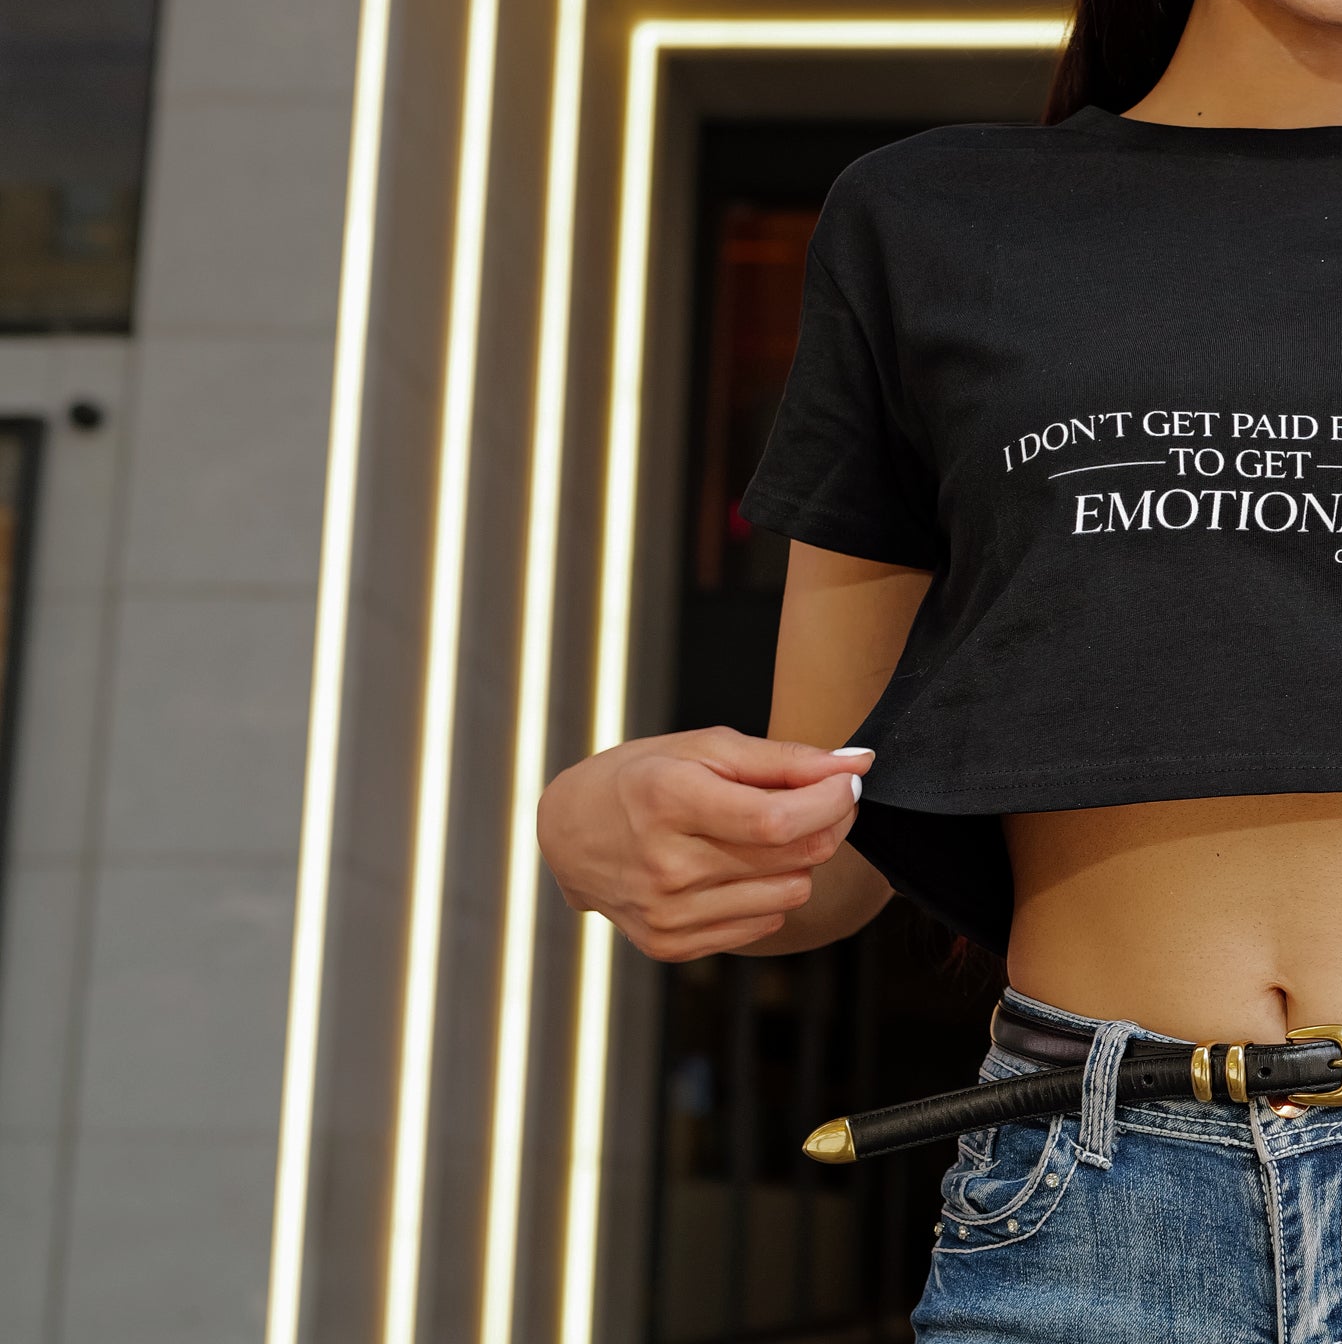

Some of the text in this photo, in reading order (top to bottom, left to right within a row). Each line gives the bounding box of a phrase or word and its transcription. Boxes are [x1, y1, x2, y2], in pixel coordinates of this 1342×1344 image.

[1002, 445, 1014, 473] I
[1018, 411, 1133, 463] DON'T
[1142, 410, 1221, 437] GET
[1231, 412, 1319, 440] PAID
[1168, 447, 1312, 480] TO GET
